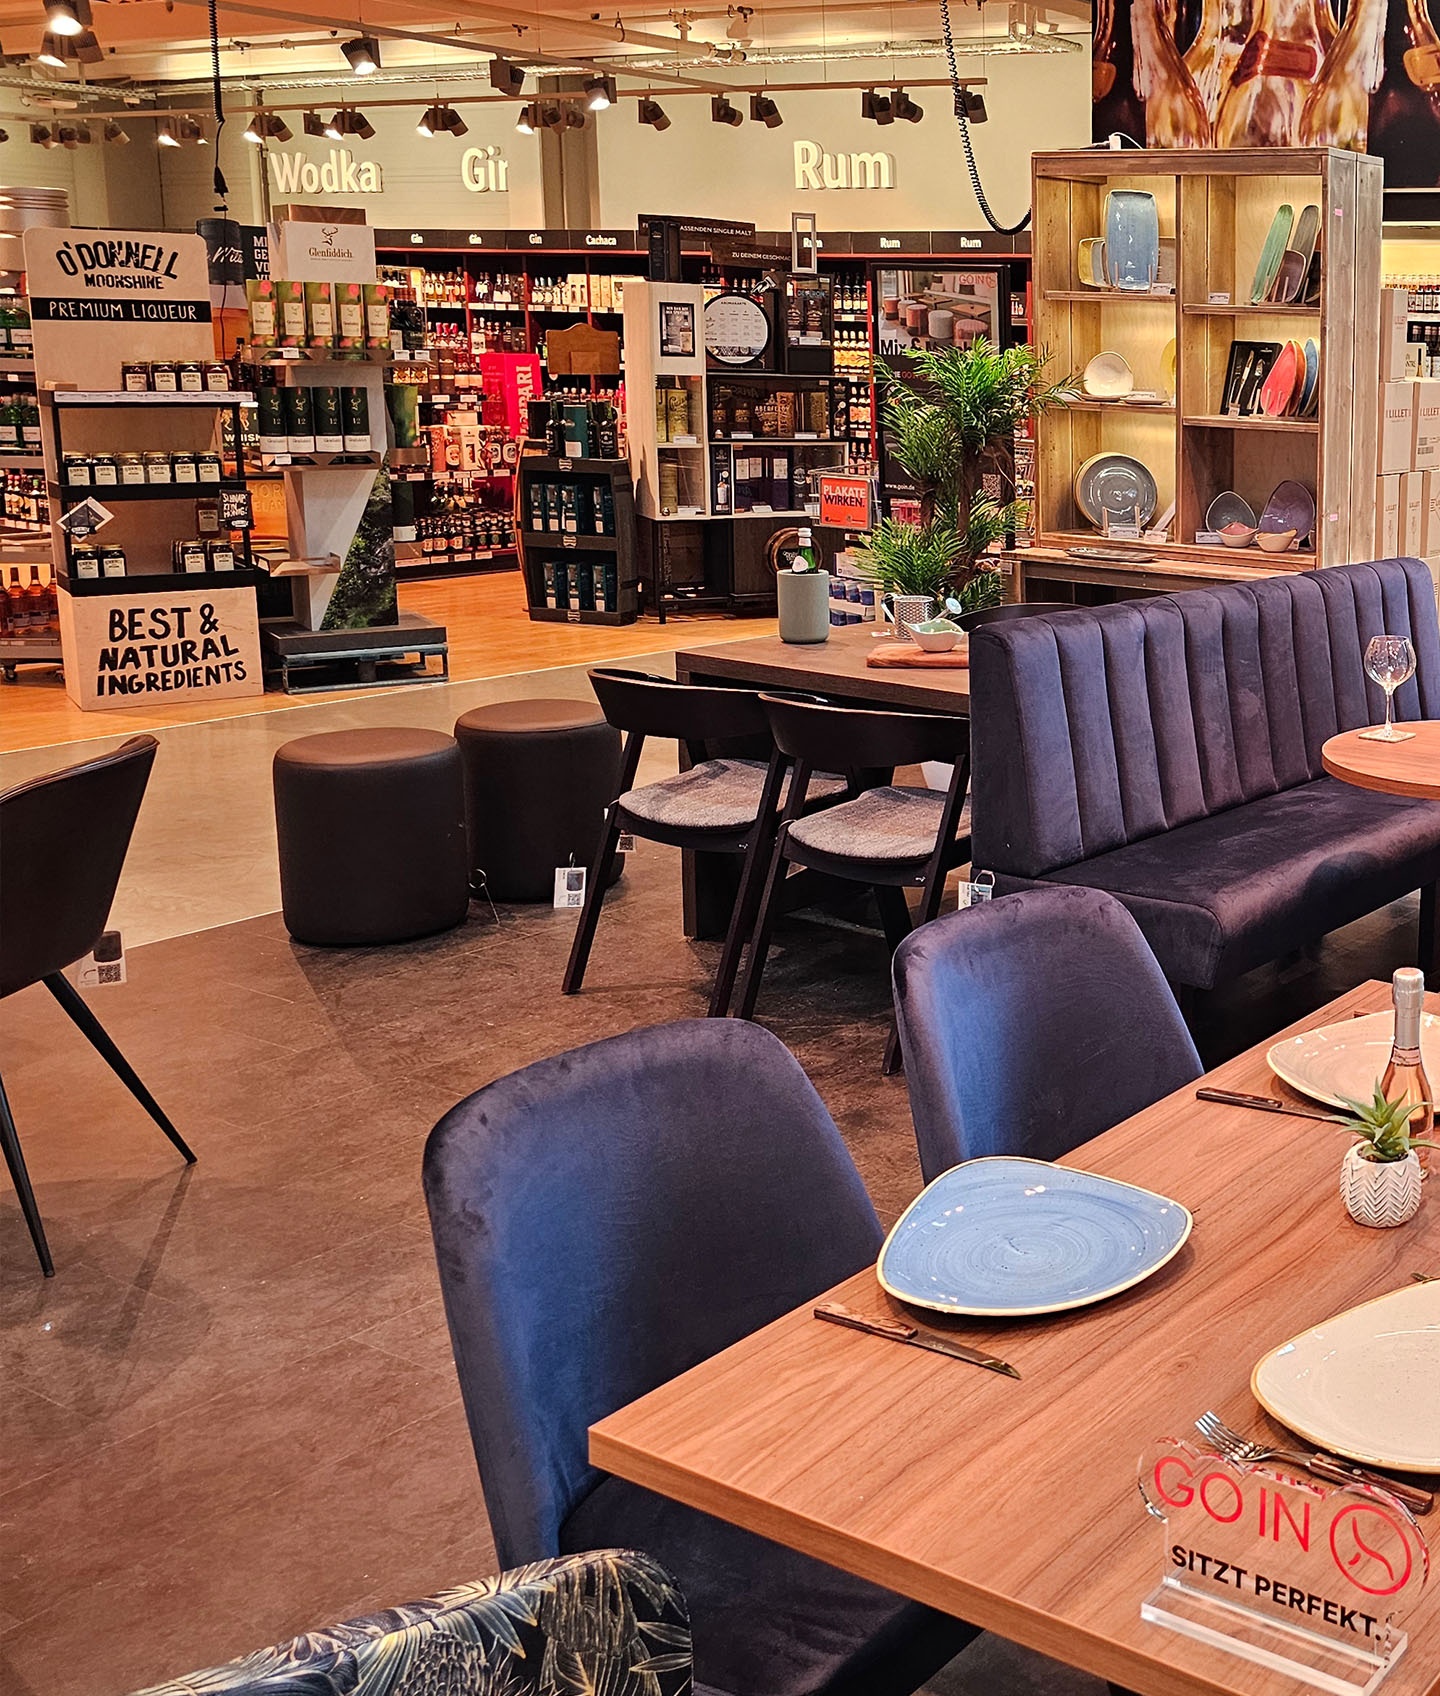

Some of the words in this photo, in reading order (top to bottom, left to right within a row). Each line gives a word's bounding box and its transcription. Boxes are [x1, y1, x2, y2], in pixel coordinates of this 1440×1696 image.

[793, 139, 894, 190] Rum
[269, 149, 383, 194] Wodka
[679, 225, 712, 233] ASSENDEN
[713, 227, 734, 235] SINGLE
[411, 233, 424, 244] Gin
[468, 234, 482, 245] Gin
[528, 233, 542, 245] Gin
[585, 235, 617, 246] Cachaca
[880, 237, 901, 248] Rum
[960, 237, 982, 248] Rum
[308, 247, 353, 258] Glenfiddich
[84, 273, 165, 289] MOONSHINE
[50, 301, 124, 318] PREMIUM
[132, 303, 197, 320] LIQUEUR
[823, 485, 866, 498] PLAKATE
[824, 495, 865, 508] WIRKEN.
[109, 606, 191, 642] BEST
[200, 603, 219, 634] &
[99, 634, 239, 672] NATURAL
[97, 661, 247, 696] INGREDIENTS
[1154, 1455, 1244, 1523] GO
[1258, 1487, 1310, 1553] IN
[1171, 1544, 1247, 1589] SITZT
[1254, 1574, 1383, 1641] PERFEKT.
